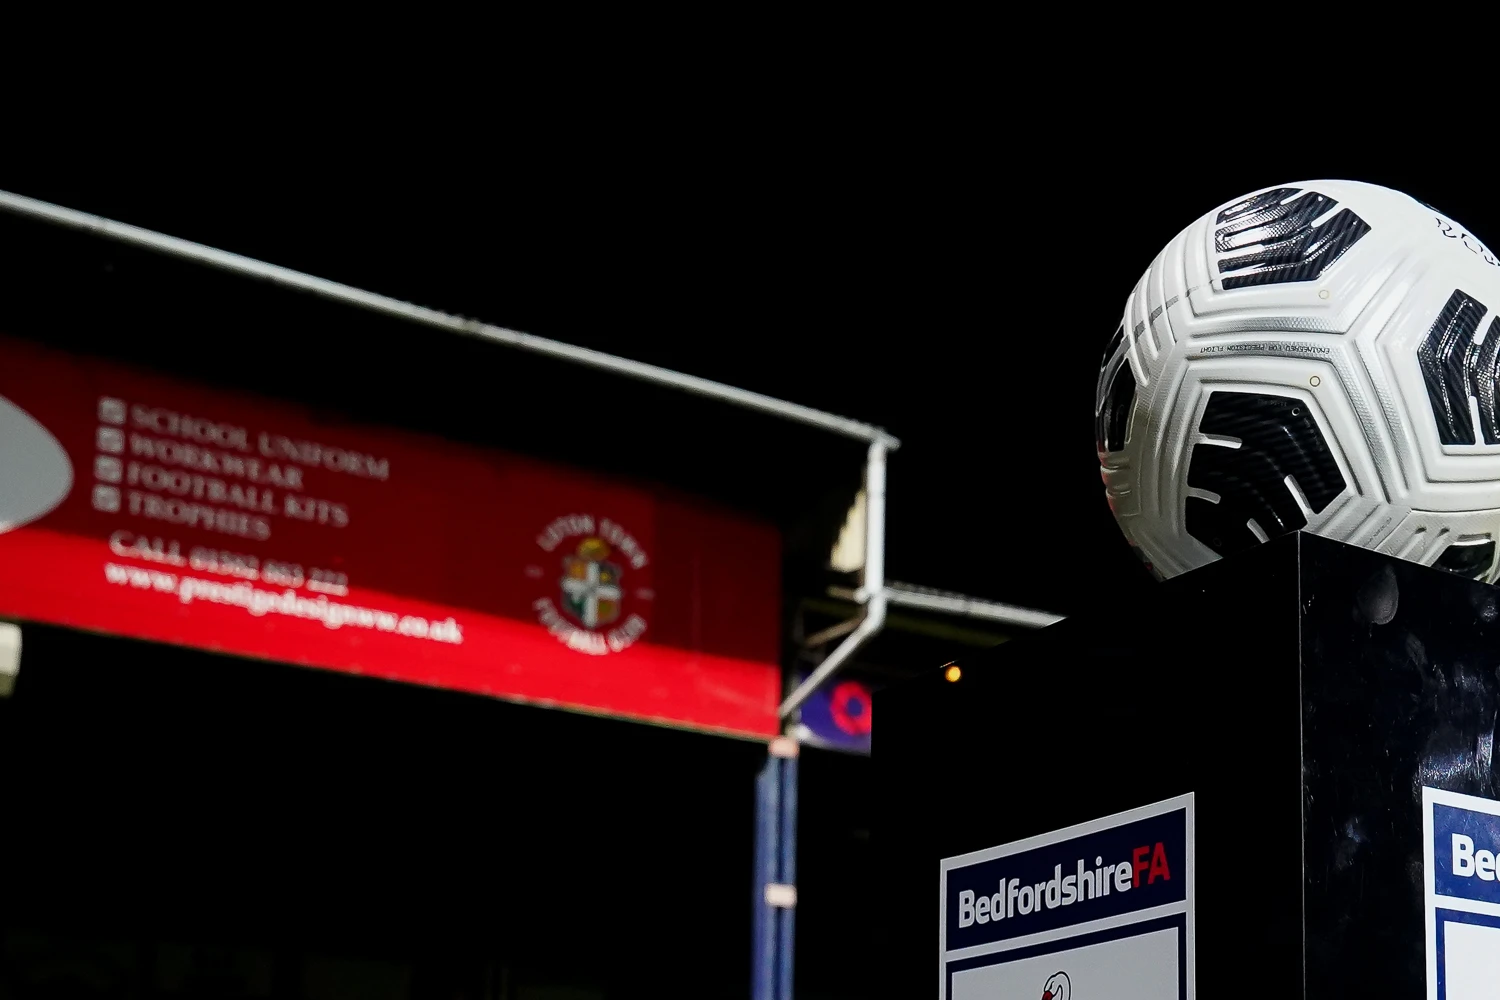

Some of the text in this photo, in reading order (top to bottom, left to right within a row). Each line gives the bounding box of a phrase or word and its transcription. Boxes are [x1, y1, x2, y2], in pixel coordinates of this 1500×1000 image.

[1199, 343, 1330, 355] ENGINEERED FOR PRECISION FLIGHT
[129, 432, 304, 492] WORKWEAR
[131, 404, 390, 482] SCHOOL UNIFORM
[127, 460, 350, 529] FOOTBALL KITS
[128, 489, 271, 541] TROPHIES
[108, 529, 187, 568] CALL
[536, 513, 649, 570] LUTON TOWN
[958, 842, 1171, 929] BedfordshireFA
